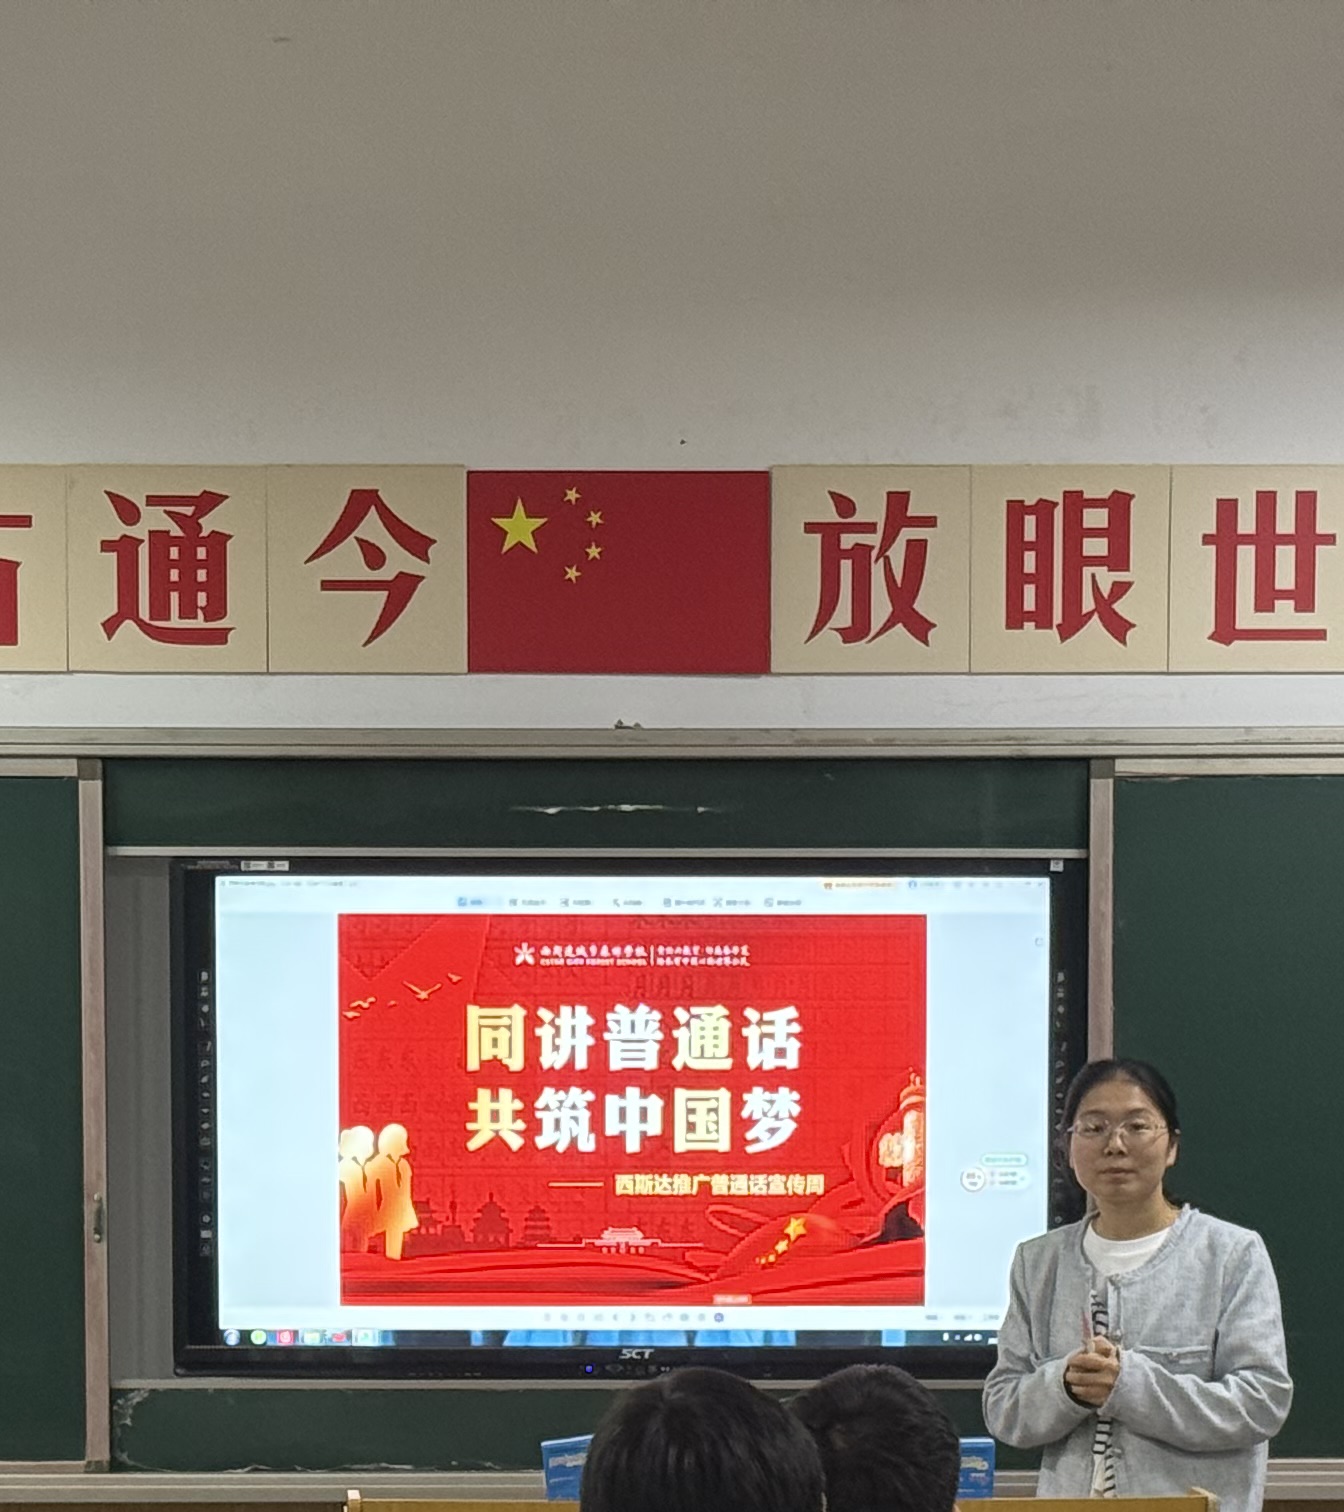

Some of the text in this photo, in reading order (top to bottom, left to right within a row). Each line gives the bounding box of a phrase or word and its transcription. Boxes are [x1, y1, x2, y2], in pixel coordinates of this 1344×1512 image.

[465, 1003, 803, 1073] 同讲普通话
[465, 1086, 803, 1155] 共筑中国梦
[614, 1173, 826, 1197] 西斯达推广普通话宣传周
